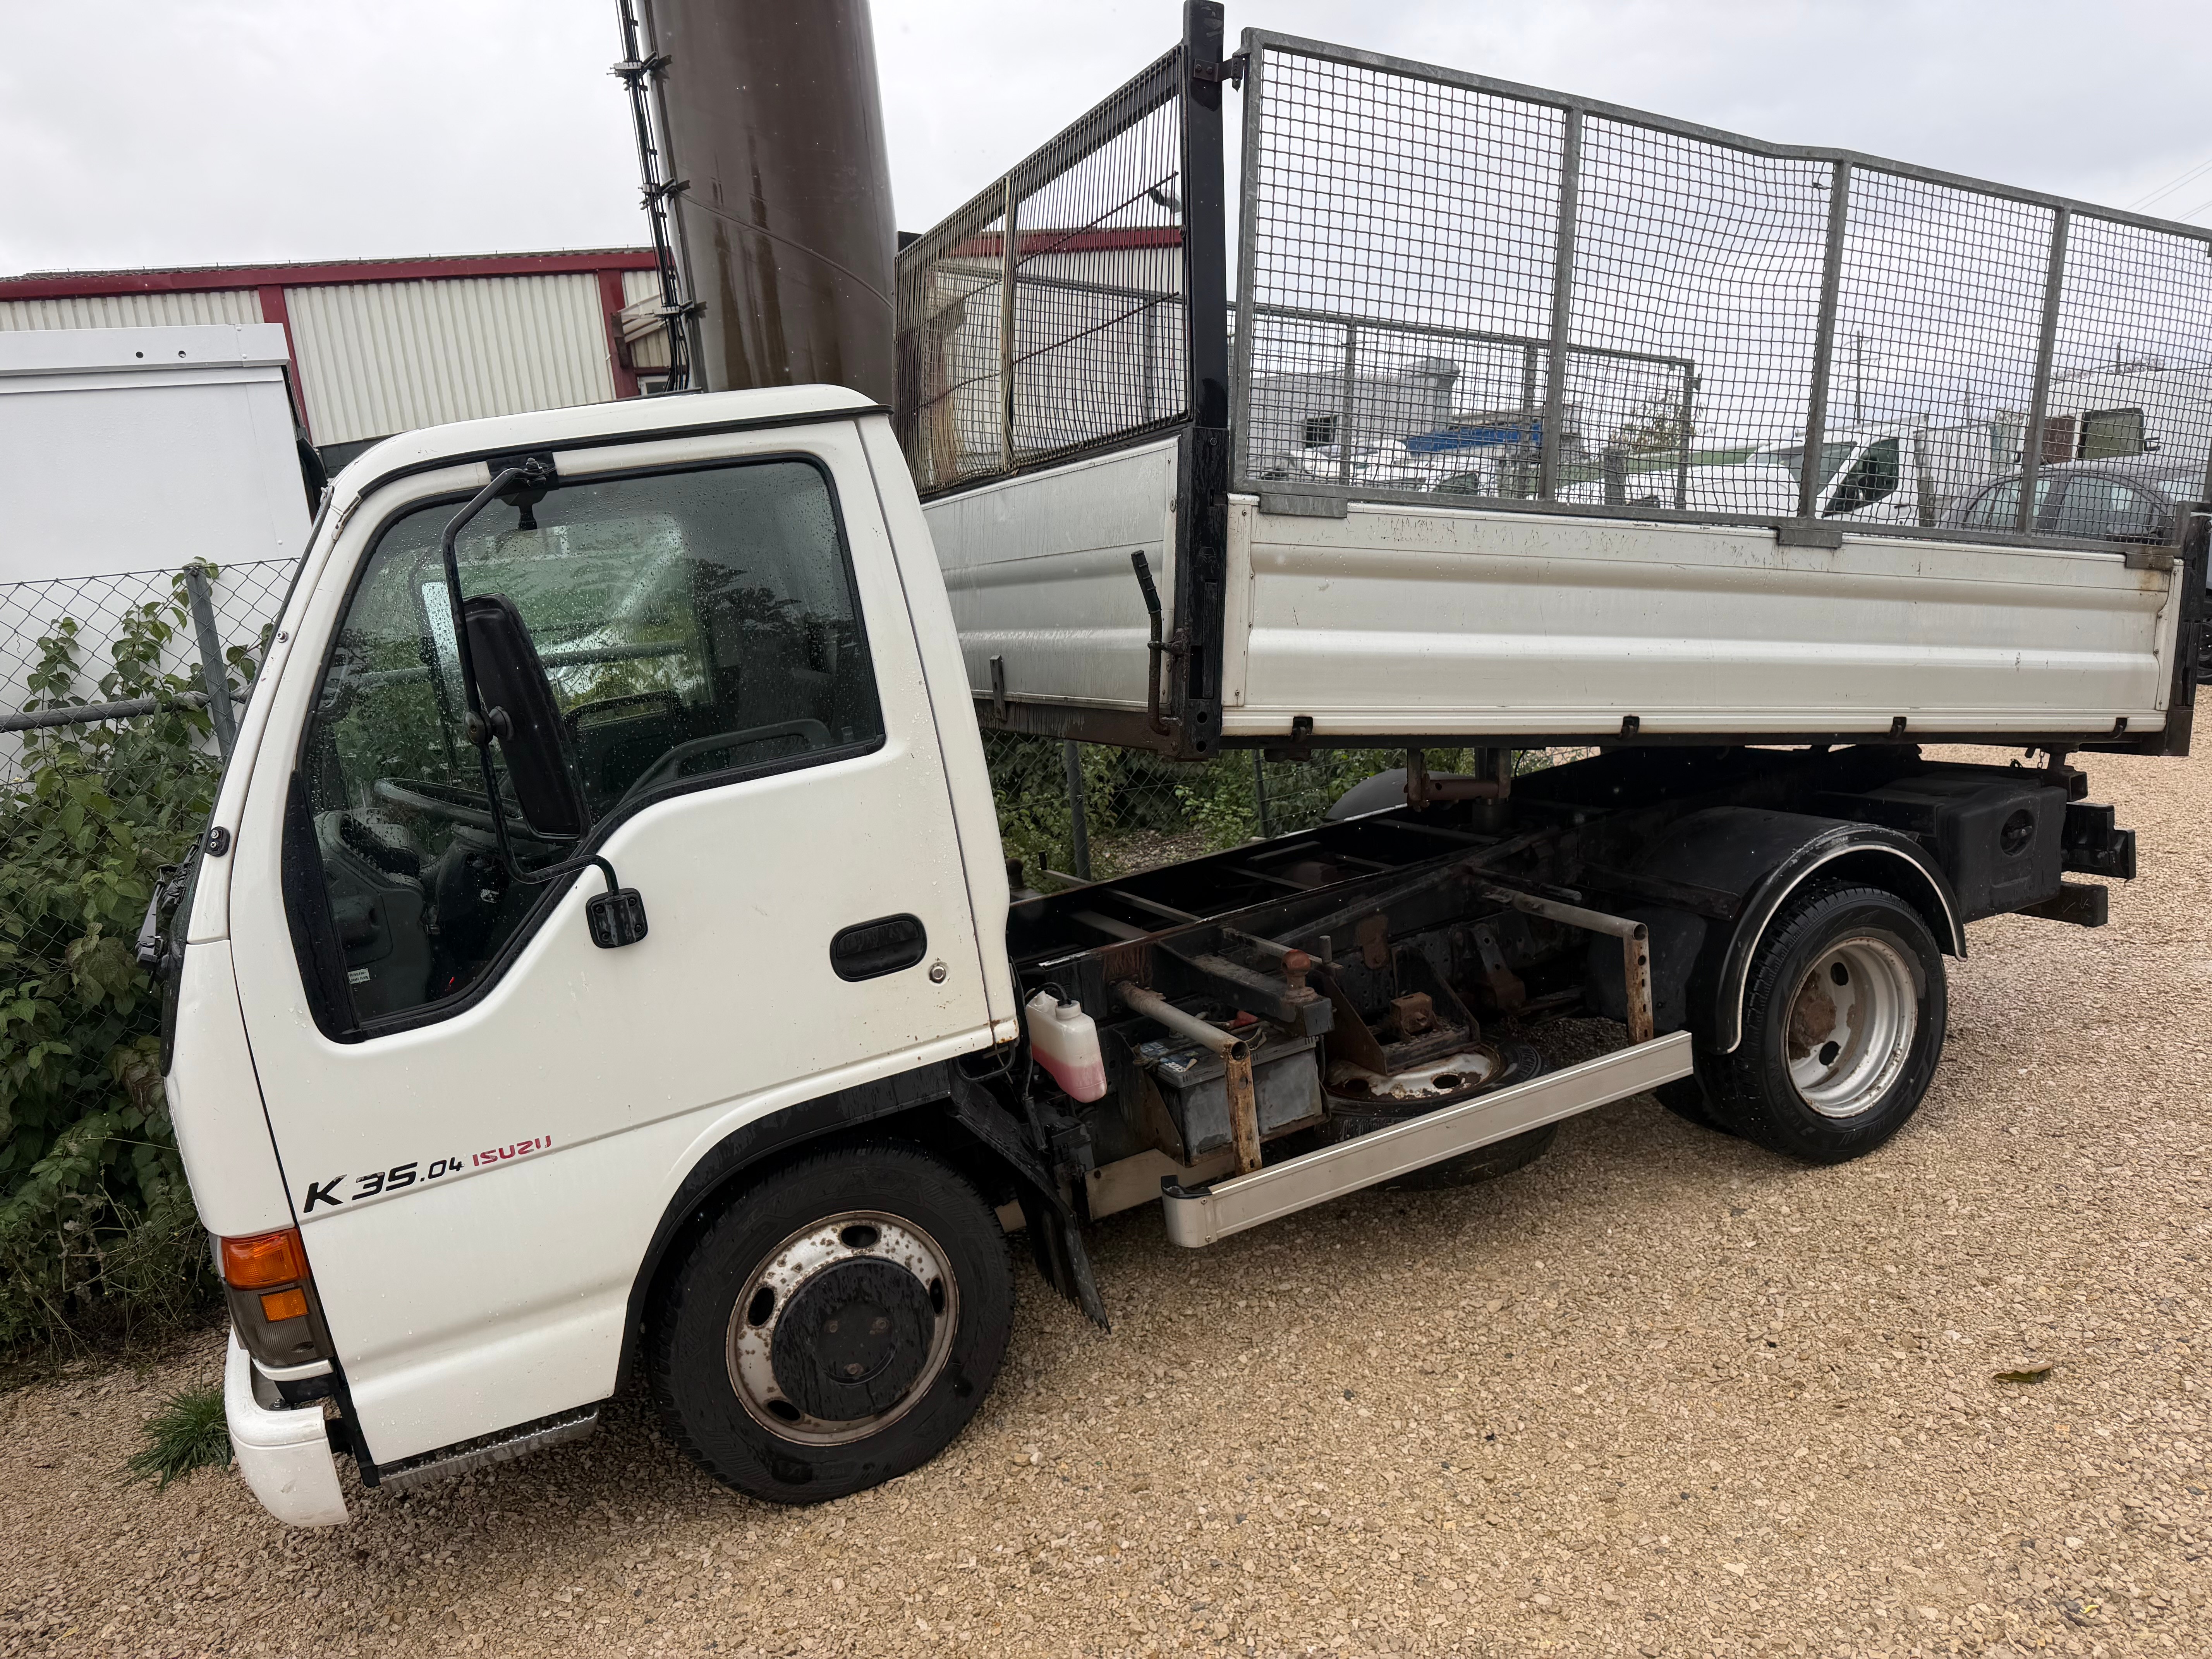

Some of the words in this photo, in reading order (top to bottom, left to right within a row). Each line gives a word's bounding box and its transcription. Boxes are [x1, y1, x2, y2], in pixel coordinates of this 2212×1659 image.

[303, 1174, 347, 1213] K
[352, 1157, 464, 1200] 35.04
[472, 1135, 551, 1166] ISUZU
